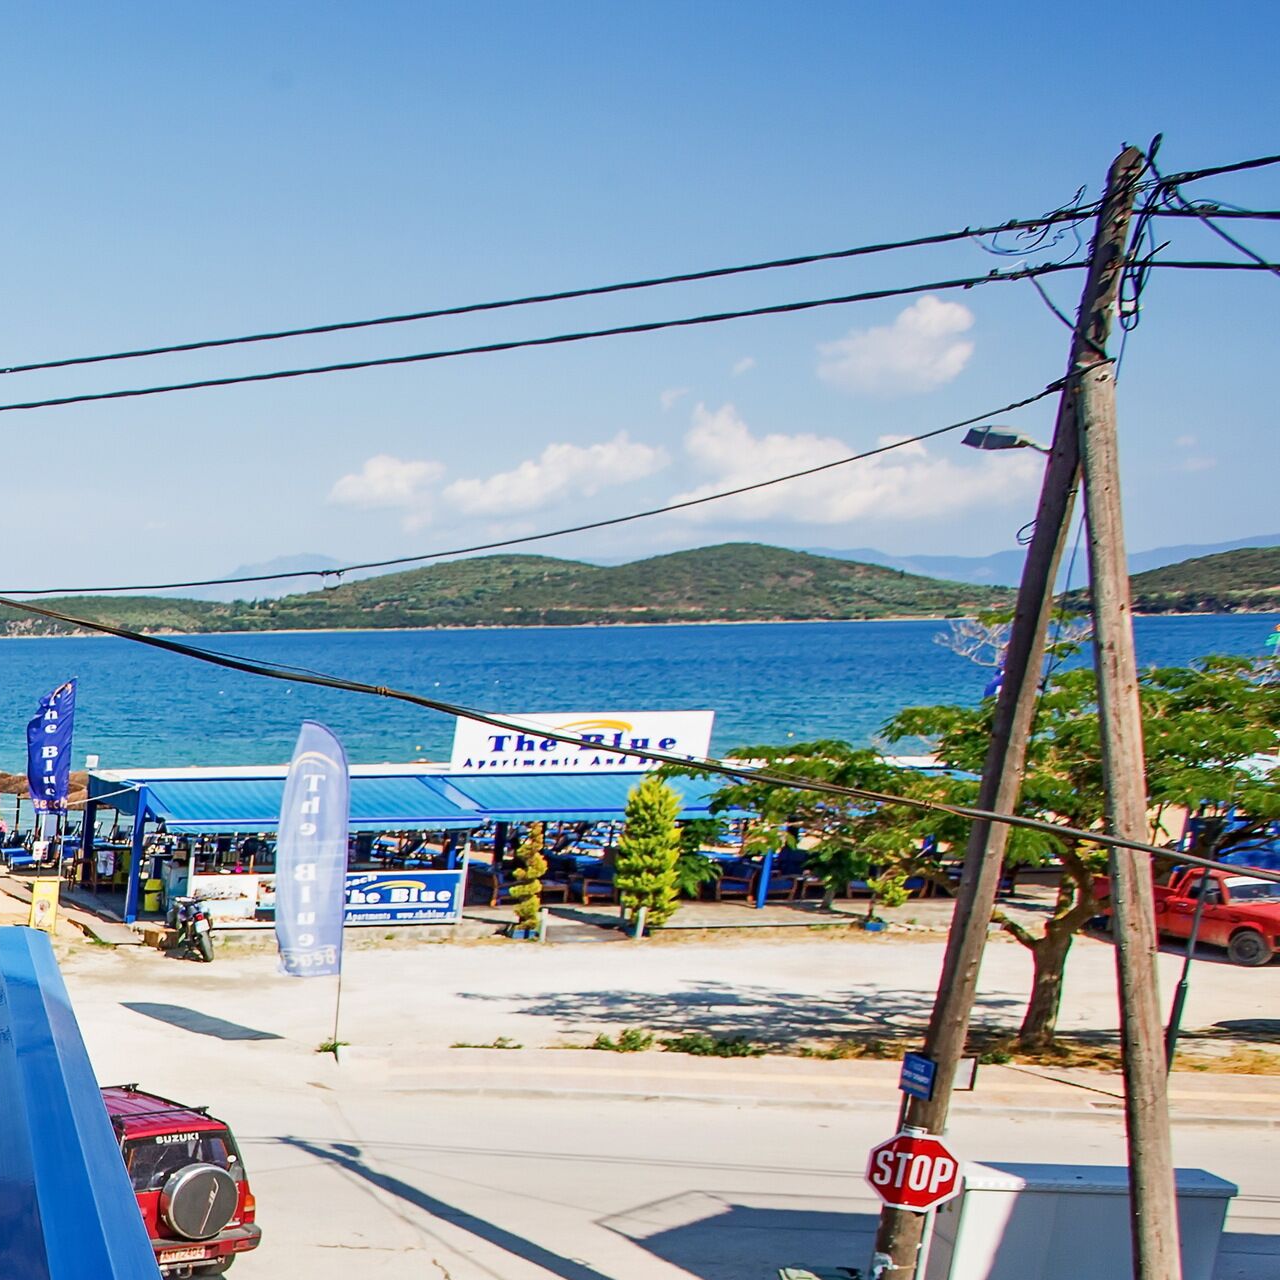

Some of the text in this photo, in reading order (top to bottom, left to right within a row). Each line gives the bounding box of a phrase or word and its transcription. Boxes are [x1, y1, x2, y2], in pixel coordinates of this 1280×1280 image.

[488, 730, 678, 753] The Blue
[463, 756, 580, 770] Apartments
[42, 745, 59, 797] Blue
[344, 874, 378, 889] each
[390, 888, 452, 903] Blue
[155, 1132, 200, 1145] SUZUKI
[873, 1150, 955, 1194] STOP
